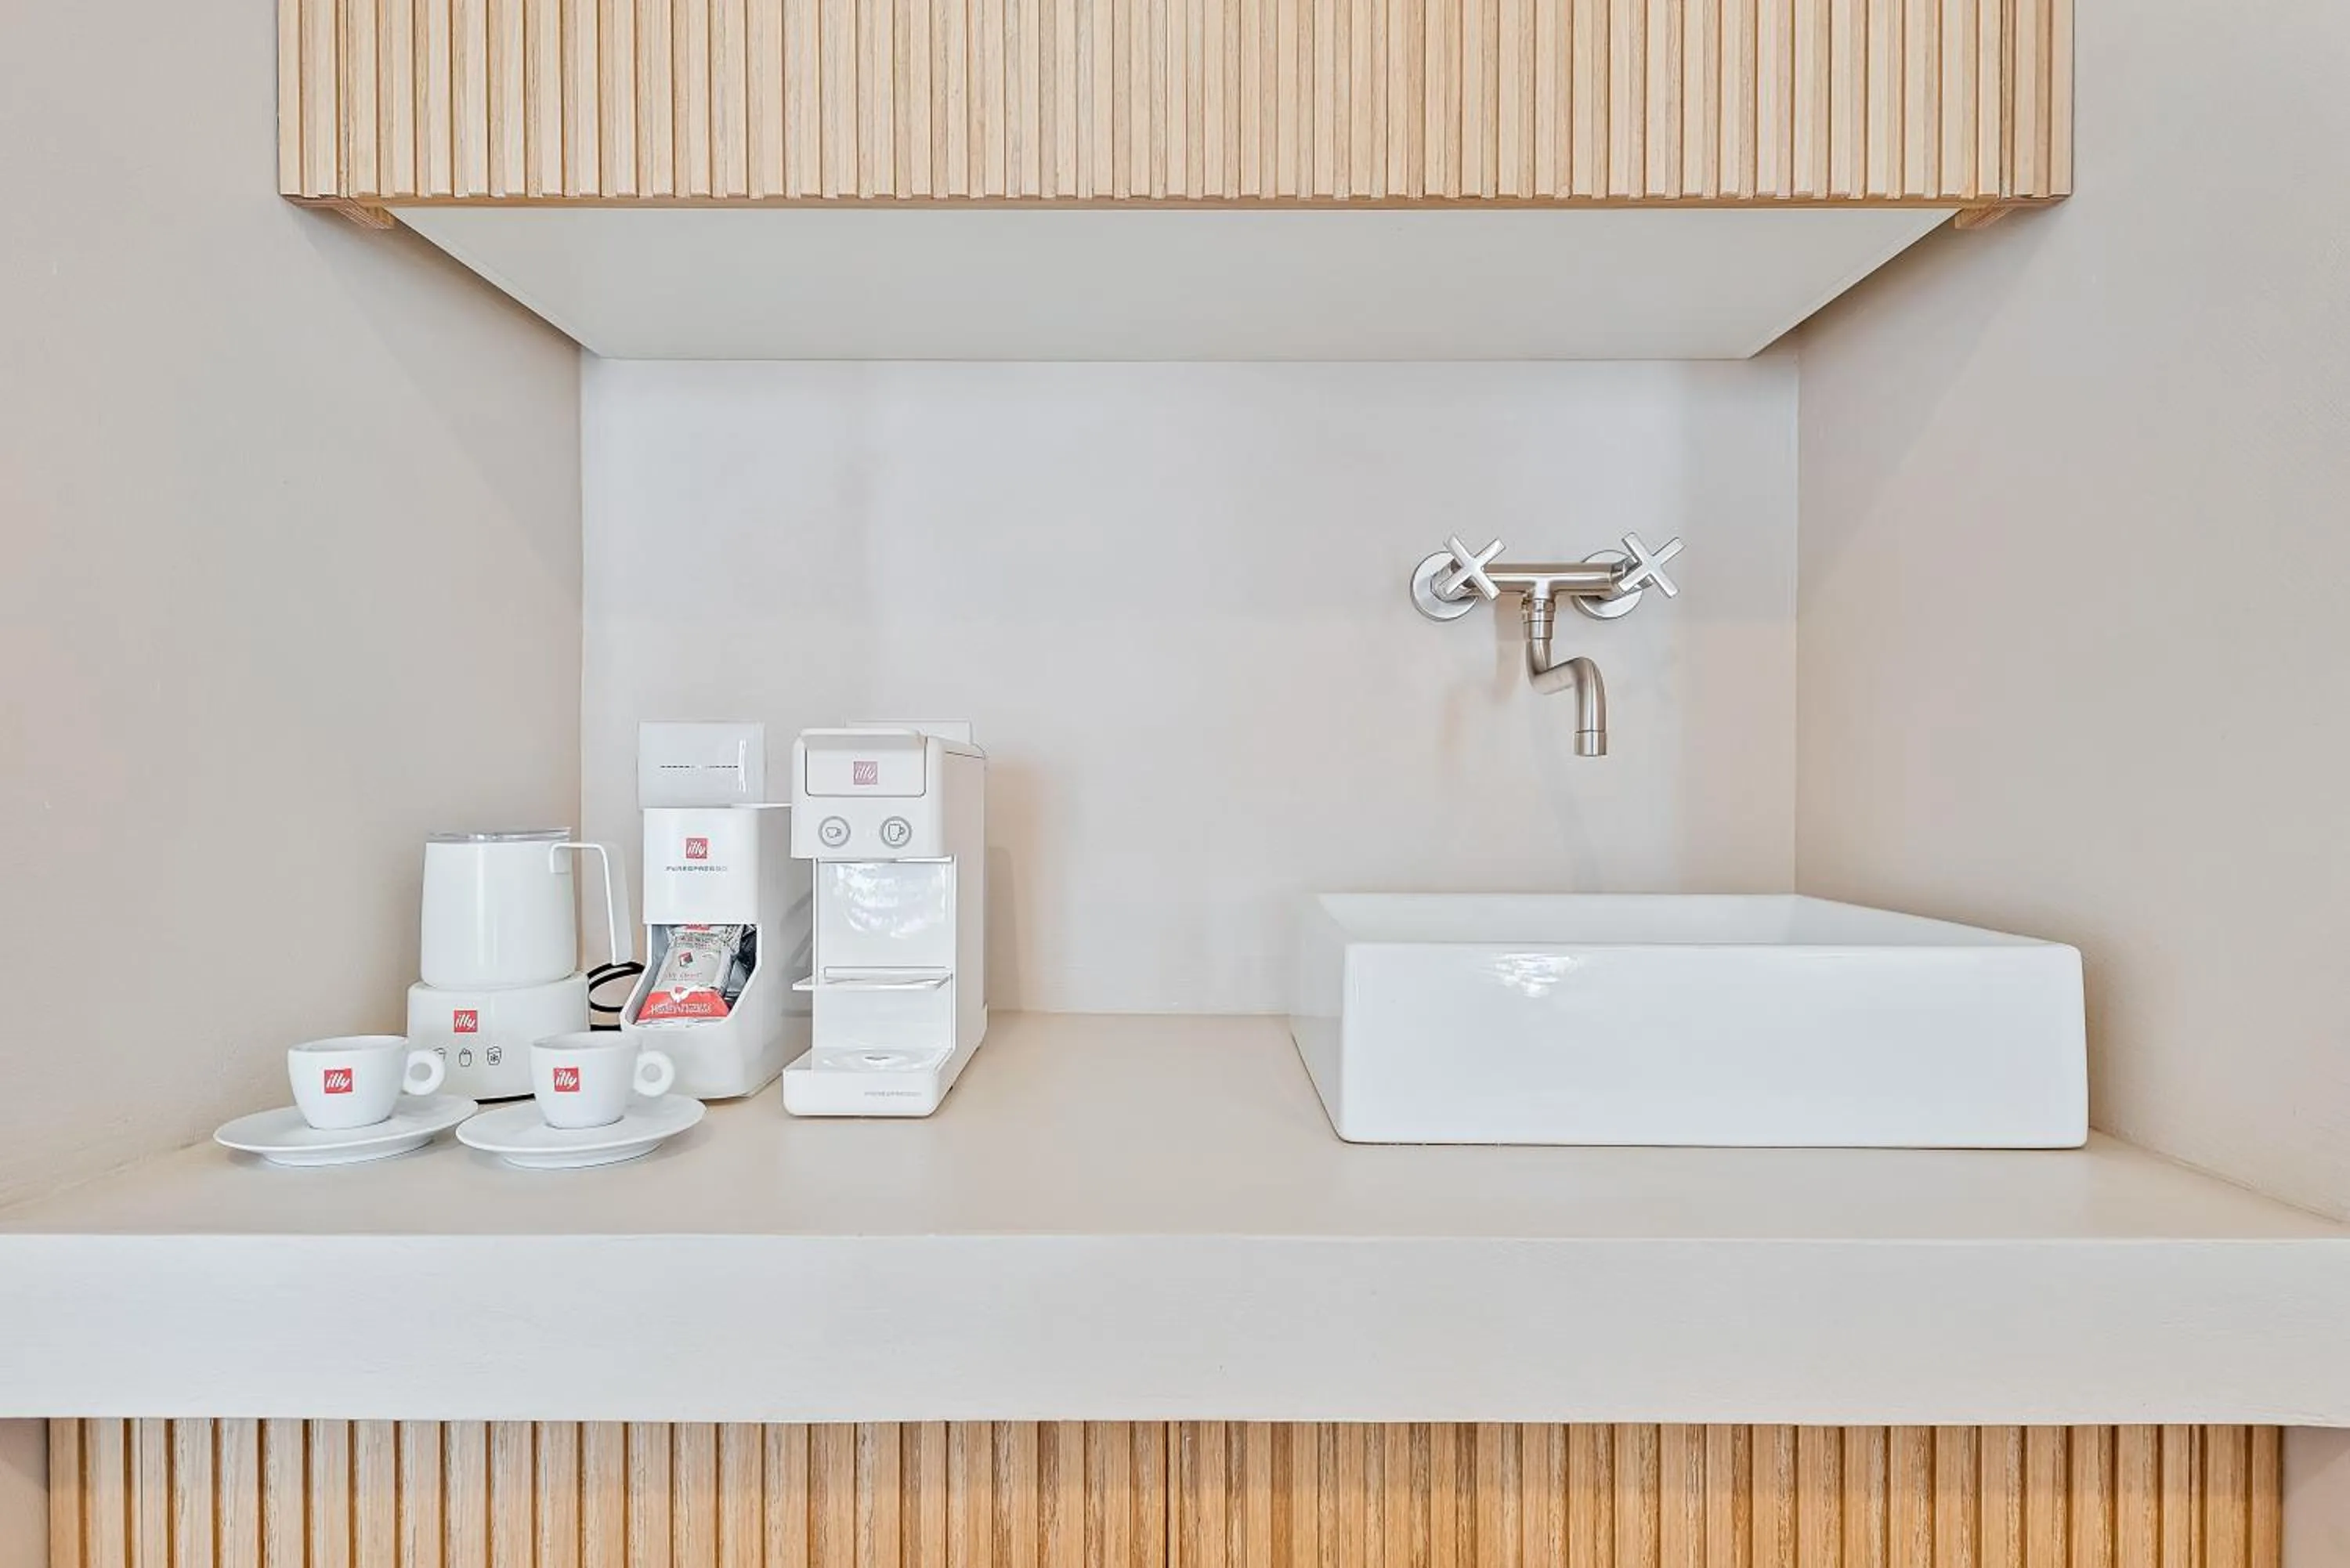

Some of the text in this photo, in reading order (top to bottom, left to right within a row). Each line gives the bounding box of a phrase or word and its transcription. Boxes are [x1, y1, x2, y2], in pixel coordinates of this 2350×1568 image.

[855, 763, 876, 781] illy
[687, 840, 707, 857] illy
[455, 1013, 476, 1029] illy
[326, 1071, 350, 1090] illy
[556, 1071, 577, 1089] illy
